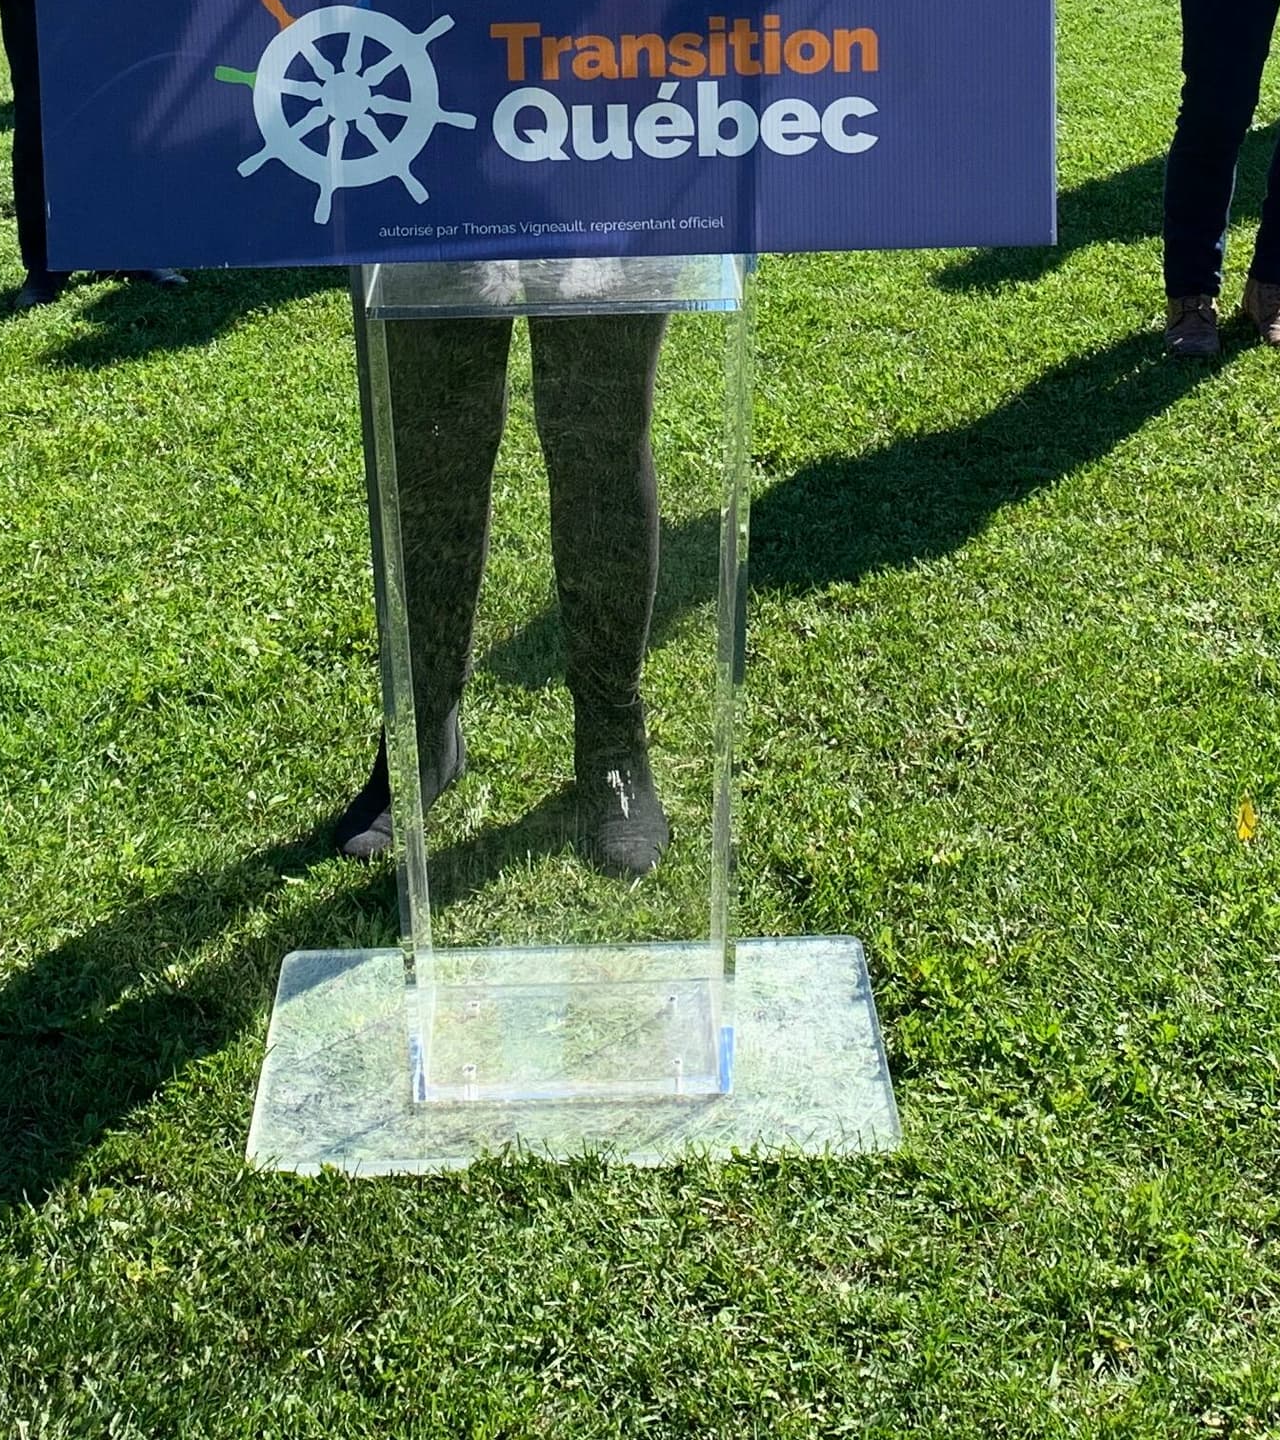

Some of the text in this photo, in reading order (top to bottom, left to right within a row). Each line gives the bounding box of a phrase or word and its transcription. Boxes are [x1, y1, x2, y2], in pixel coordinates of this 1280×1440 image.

[490, 14, 879, 81] Transition
[492, 80, 879, 162] Québec
[436, 225, 459, 238] par
[462, 222, 517, 235] Thomas
[679, 215, 725, 229] officiel
